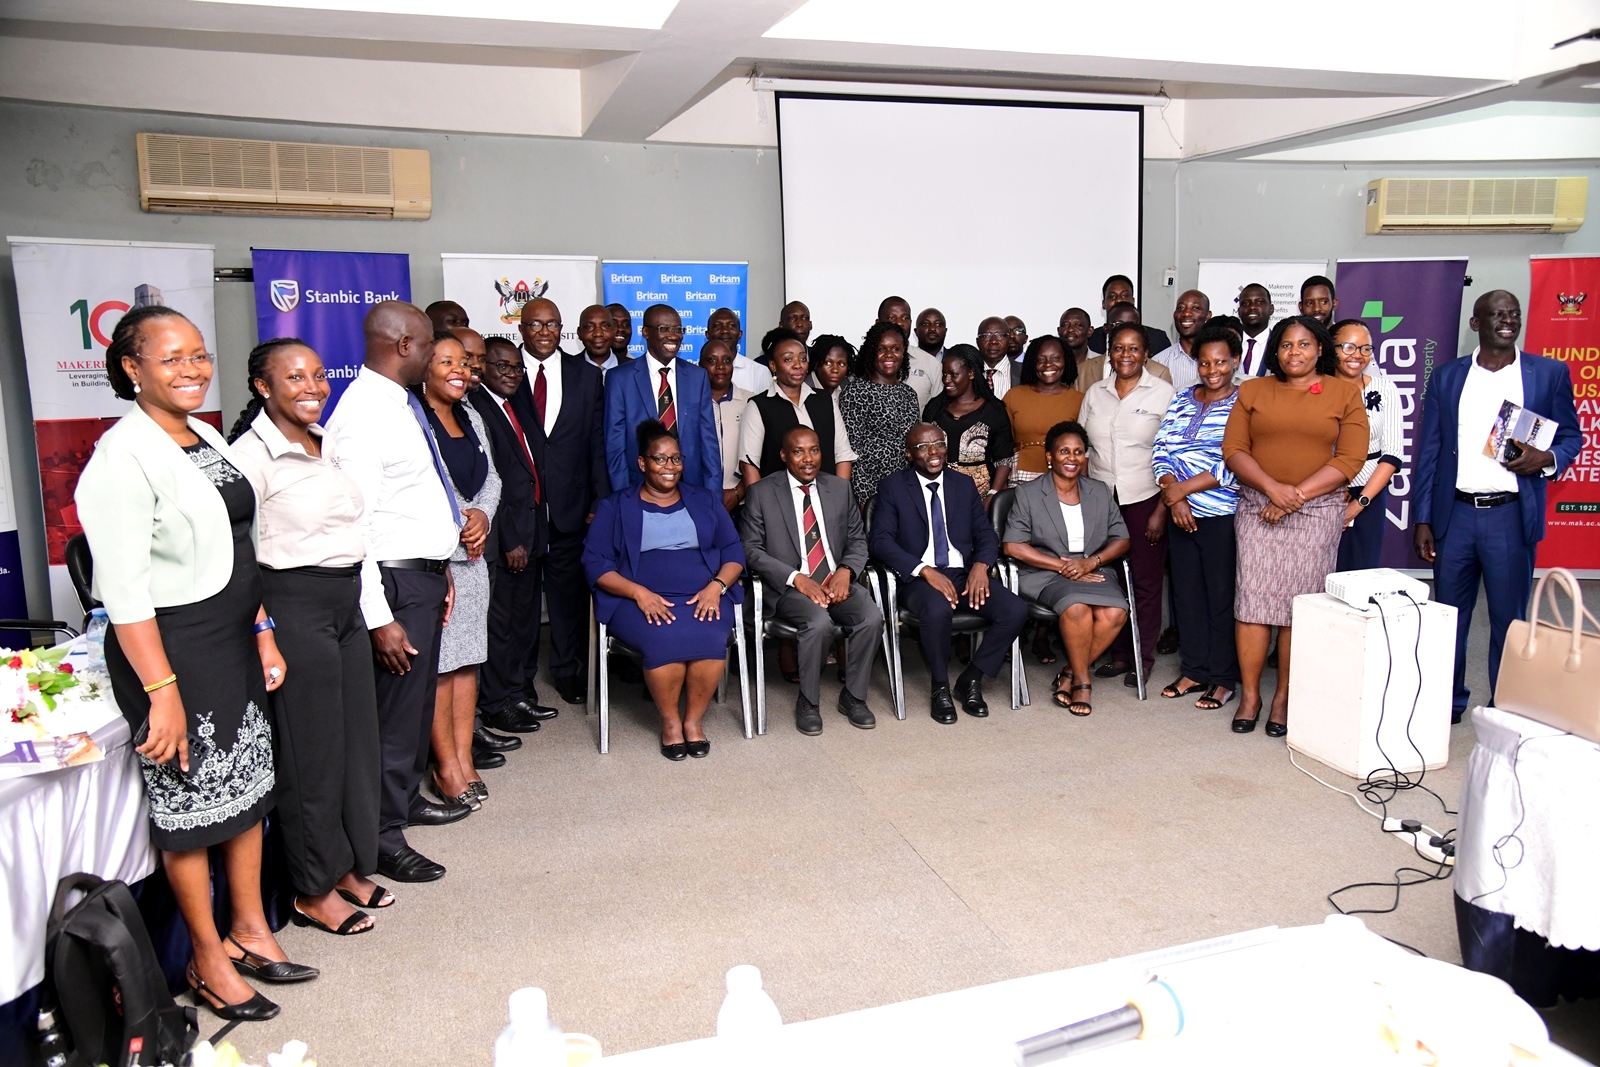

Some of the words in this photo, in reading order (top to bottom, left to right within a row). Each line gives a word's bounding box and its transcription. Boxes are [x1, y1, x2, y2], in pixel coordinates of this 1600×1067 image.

[611, 274, 643, 283] Britam
[661, 274, 692, 283] Britam
[709, 274, 741, 283] Britam
[305, 289, 360, 303] Stanbic
[636, 291, 668, 300] Britam
[685, 291, 717, 300] Britam
[1579, 504, 1598, 512] 1922
